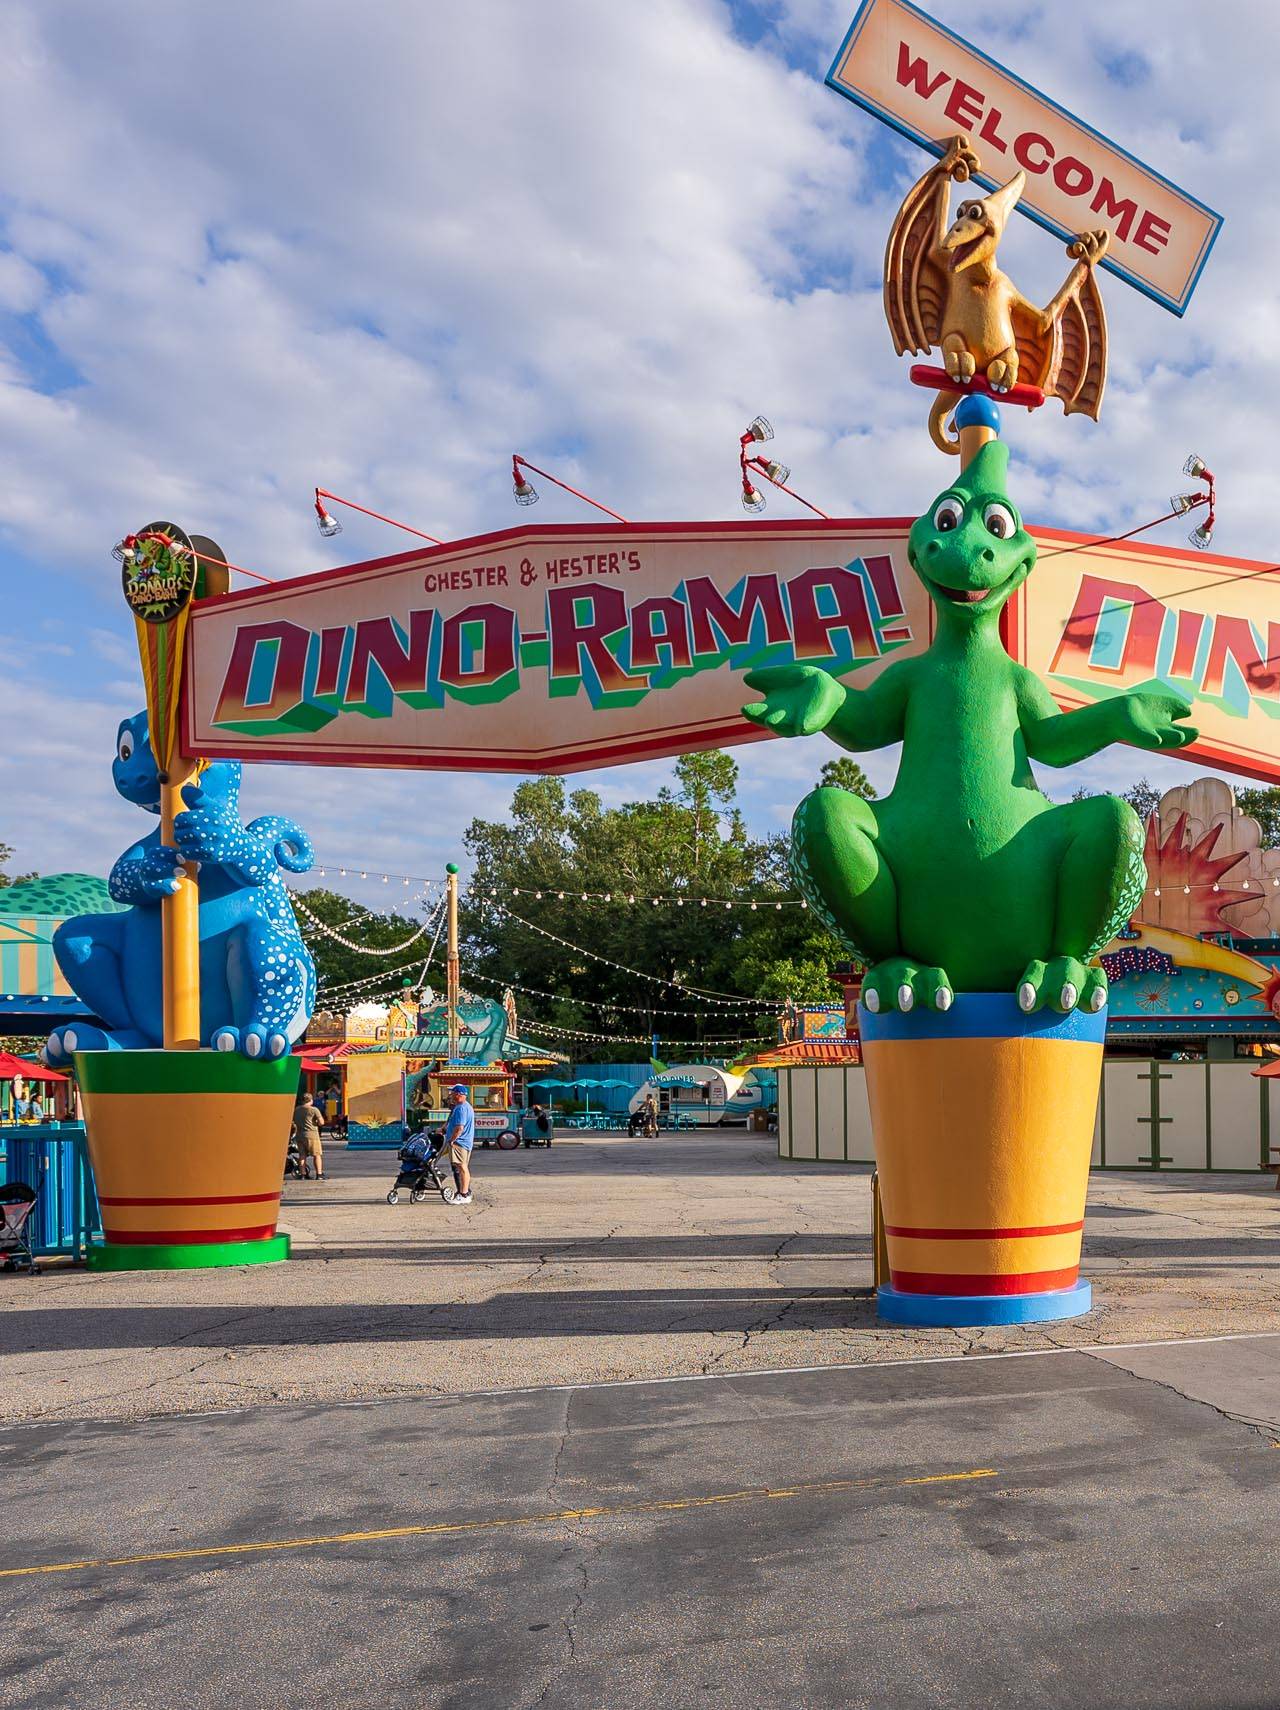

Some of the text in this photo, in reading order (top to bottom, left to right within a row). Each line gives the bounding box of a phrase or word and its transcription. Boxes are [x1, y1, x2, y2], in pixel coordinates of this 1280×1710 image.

[896, 40, 1172, 256] WELCOME
[424, 550, 642, 594] CHESTER & HESTER'S
[210, 554, 914, 736] DINO-RAMA!
[474, 1118, 505, 1126] OPCORN
